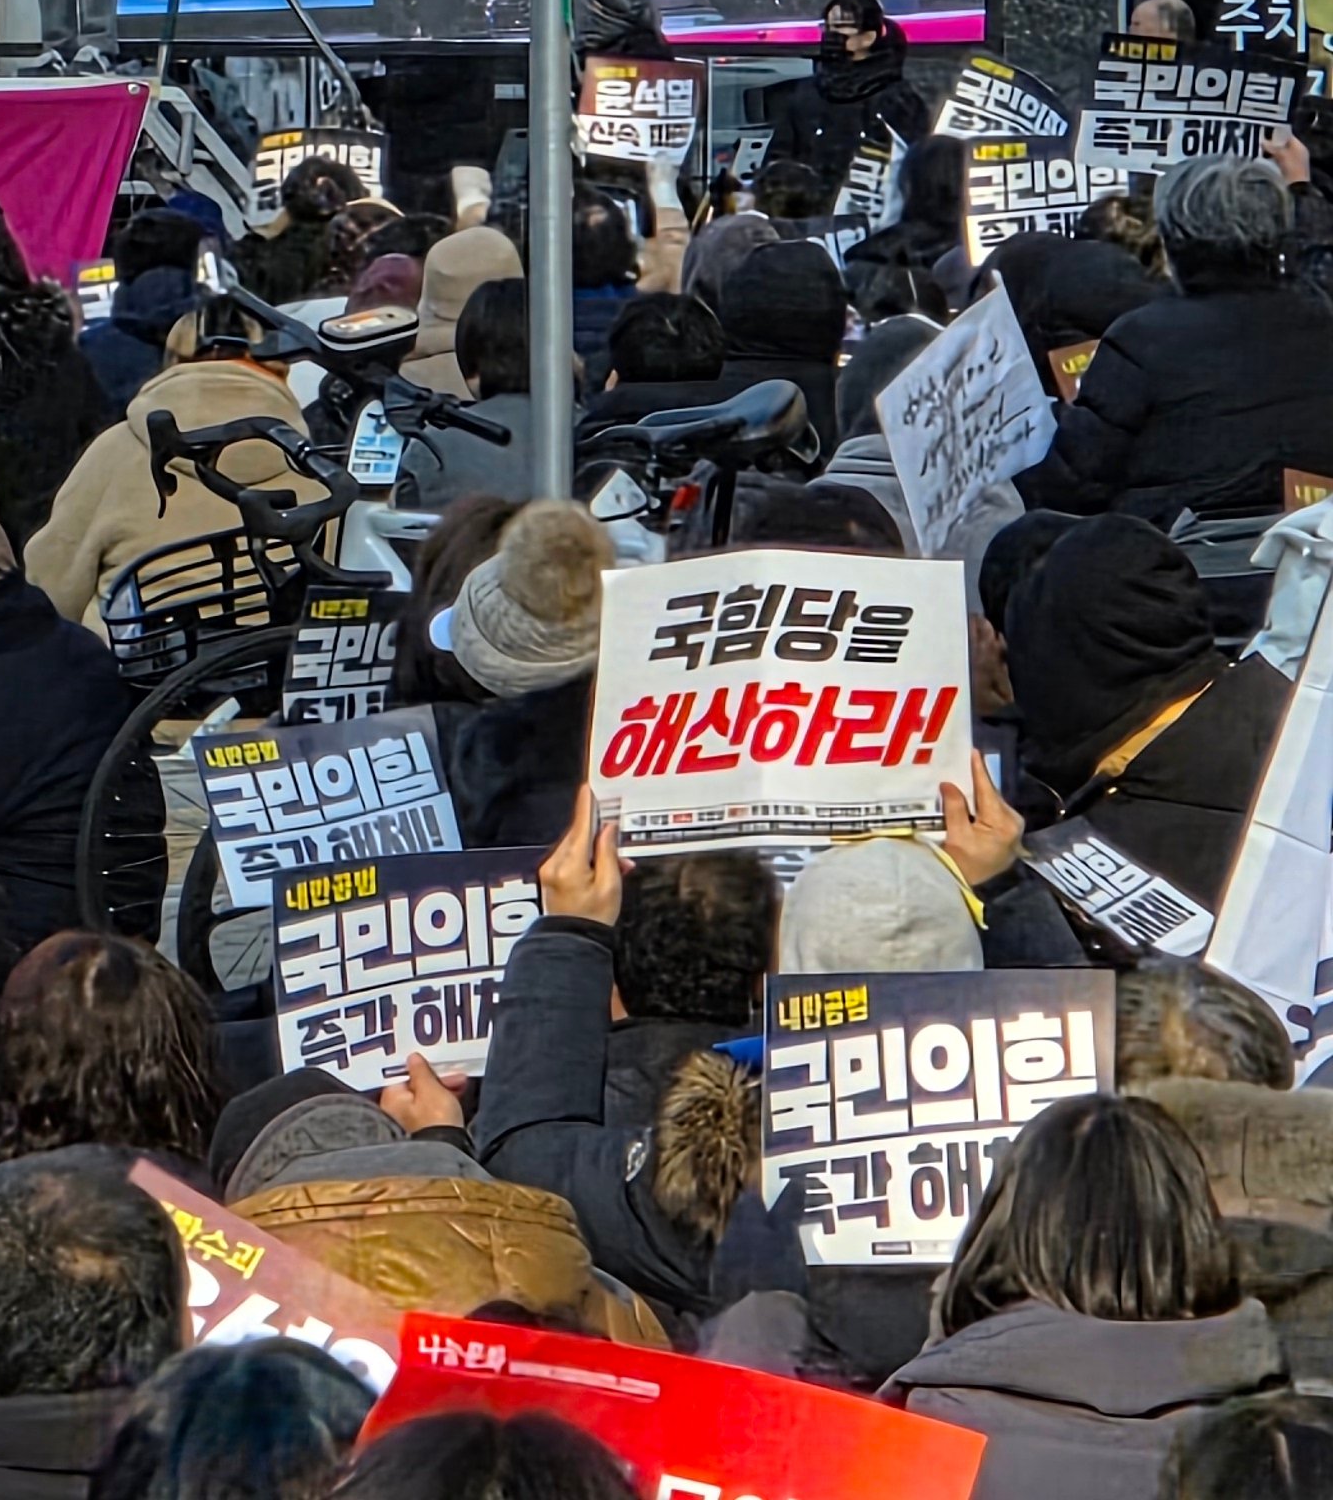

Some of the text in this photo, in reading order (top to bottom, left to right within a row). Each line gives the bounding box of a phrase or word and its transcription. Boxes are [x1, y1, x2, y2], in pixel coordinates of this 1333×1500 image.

[1093, 60, 1296, 122] 국민의힘
[649, 581, 915, 672] 국힘당을
[599, 680, 960, 780] 해산하라!
[206, 730, 440, 836] 국민의힘
[296, 986, 399, 1071] 즉각
